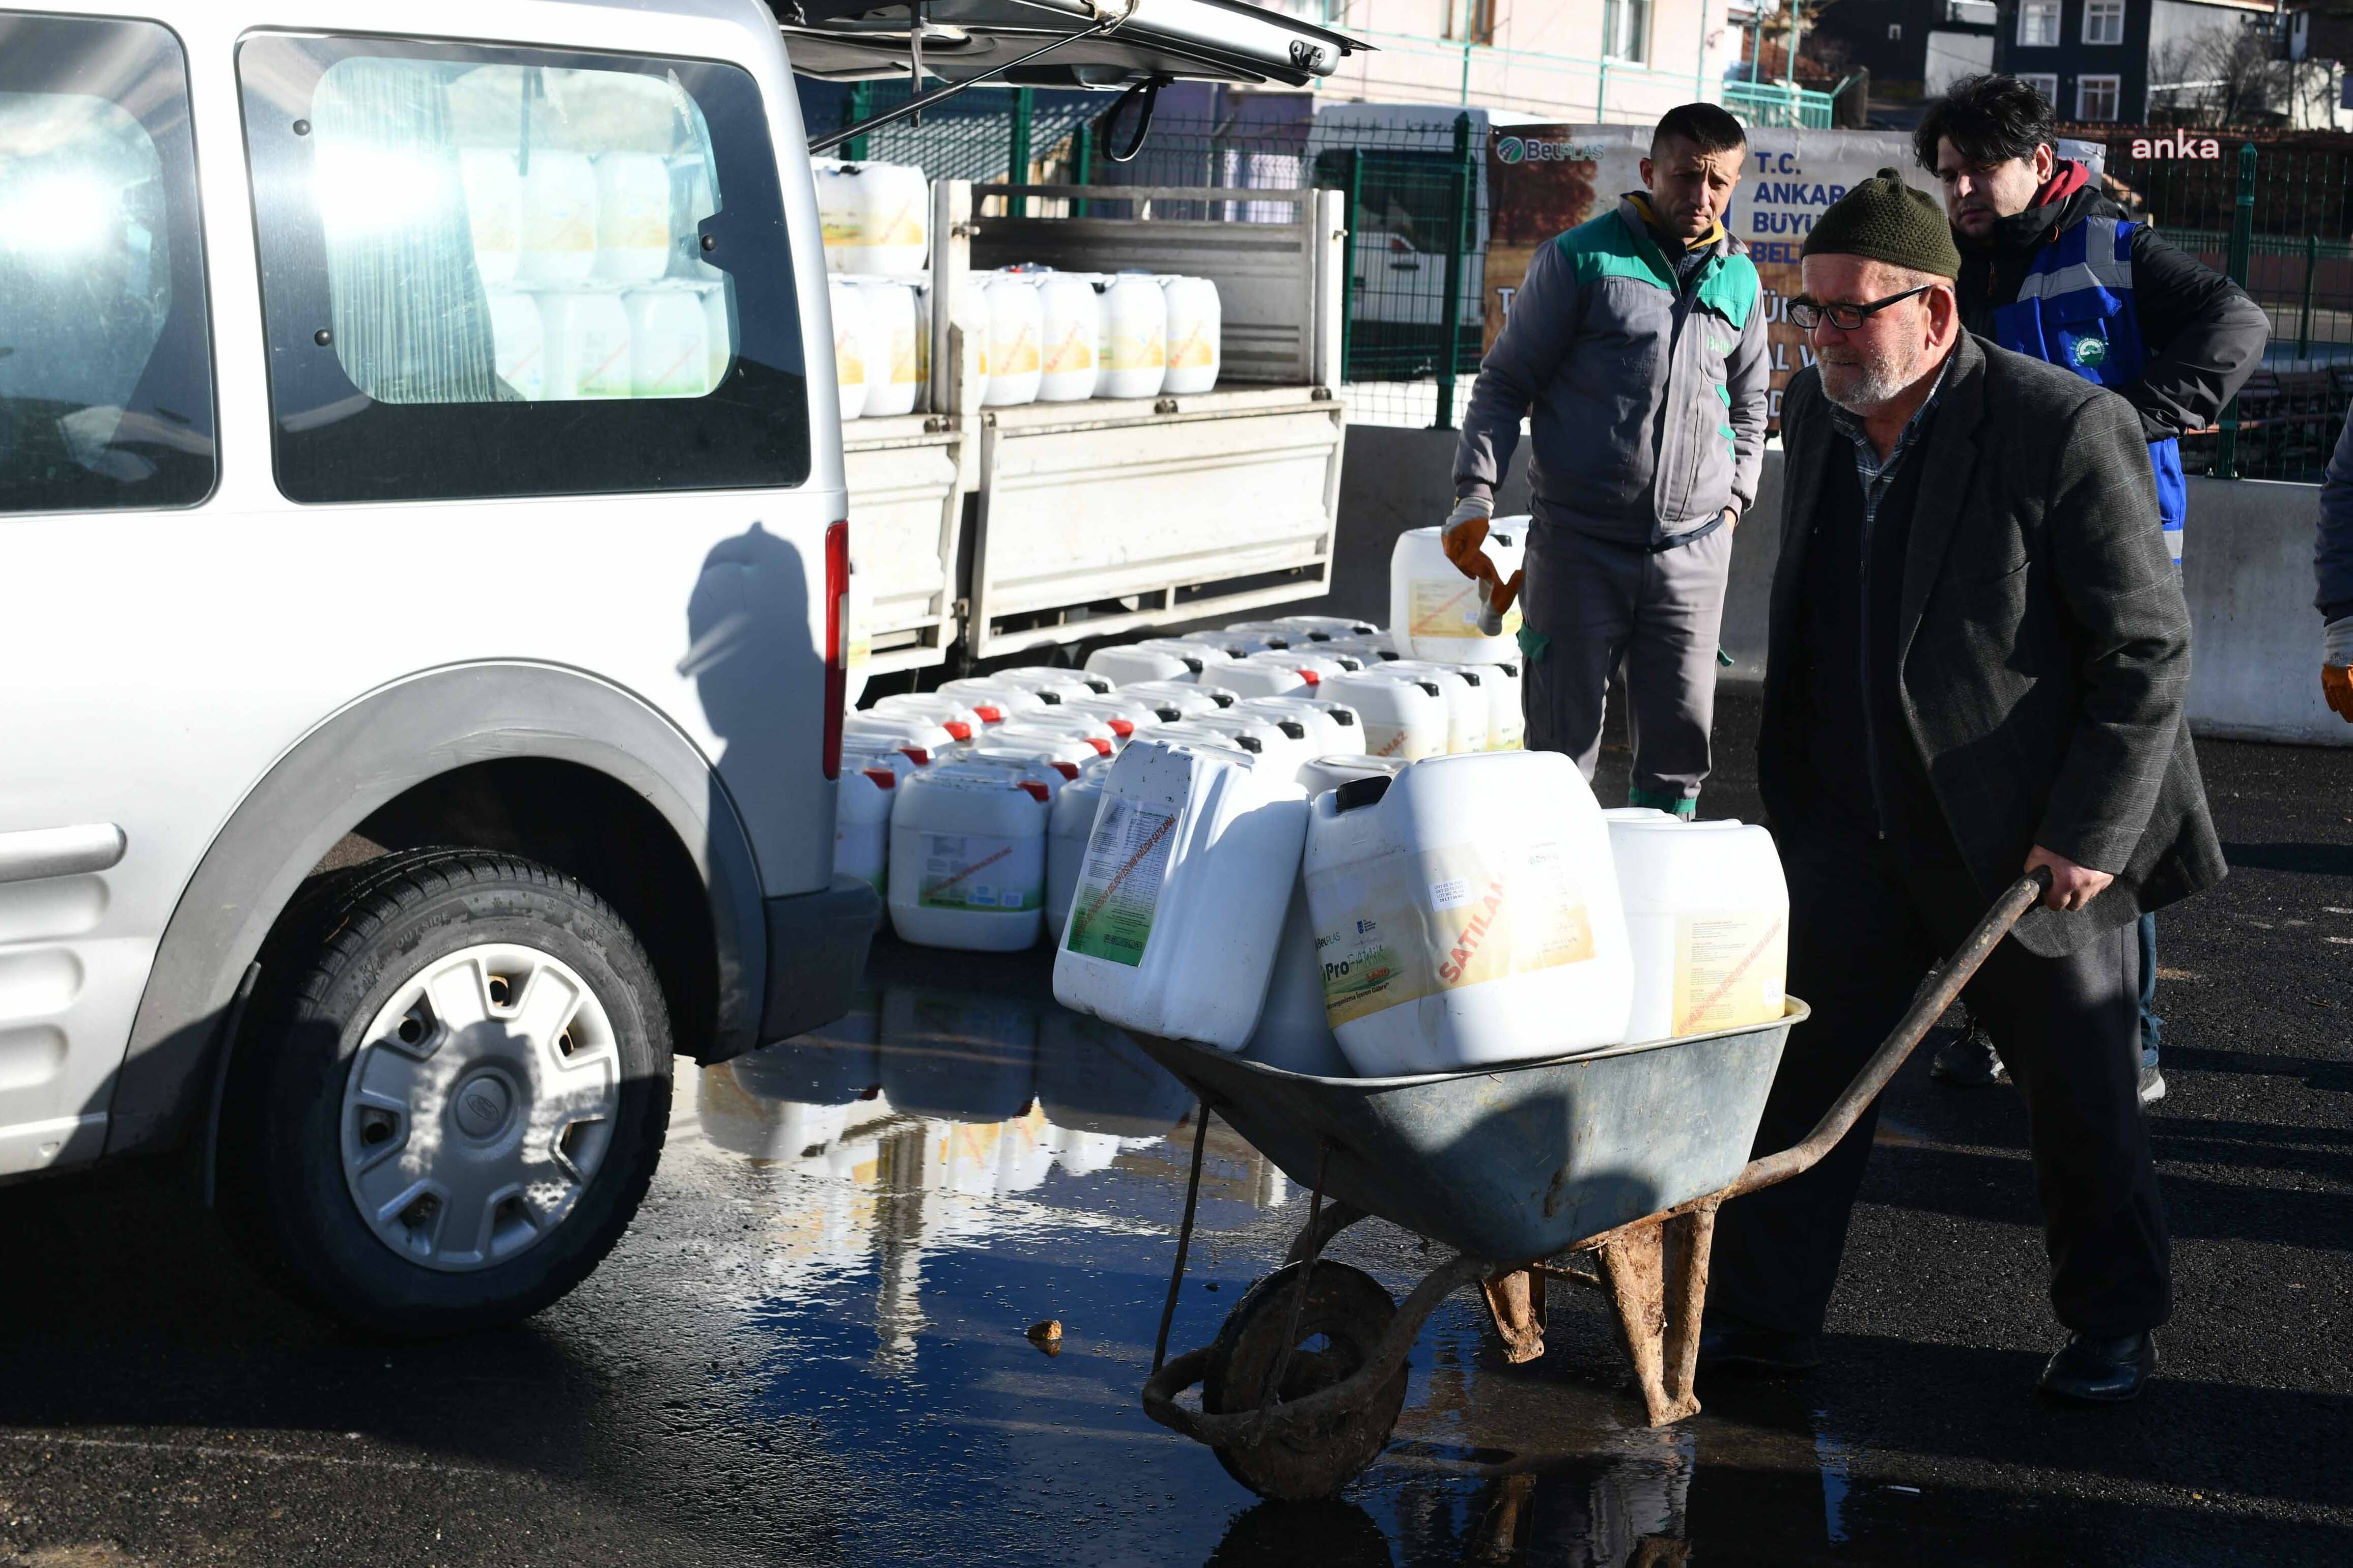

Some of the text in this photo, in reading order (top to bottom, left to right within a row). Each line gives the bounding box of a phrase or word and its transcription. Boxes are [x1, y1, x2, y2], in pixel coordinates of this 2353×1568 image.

[1755, 152, 1802, 175] T.C.
[1753, 182, 1848, 206] ANKAR
[1753, 212, 1823, 235] BÜYÜ
[395, 912, 450, 949] OUTSIDE
[1366, 965, 1390, 983] LAND
